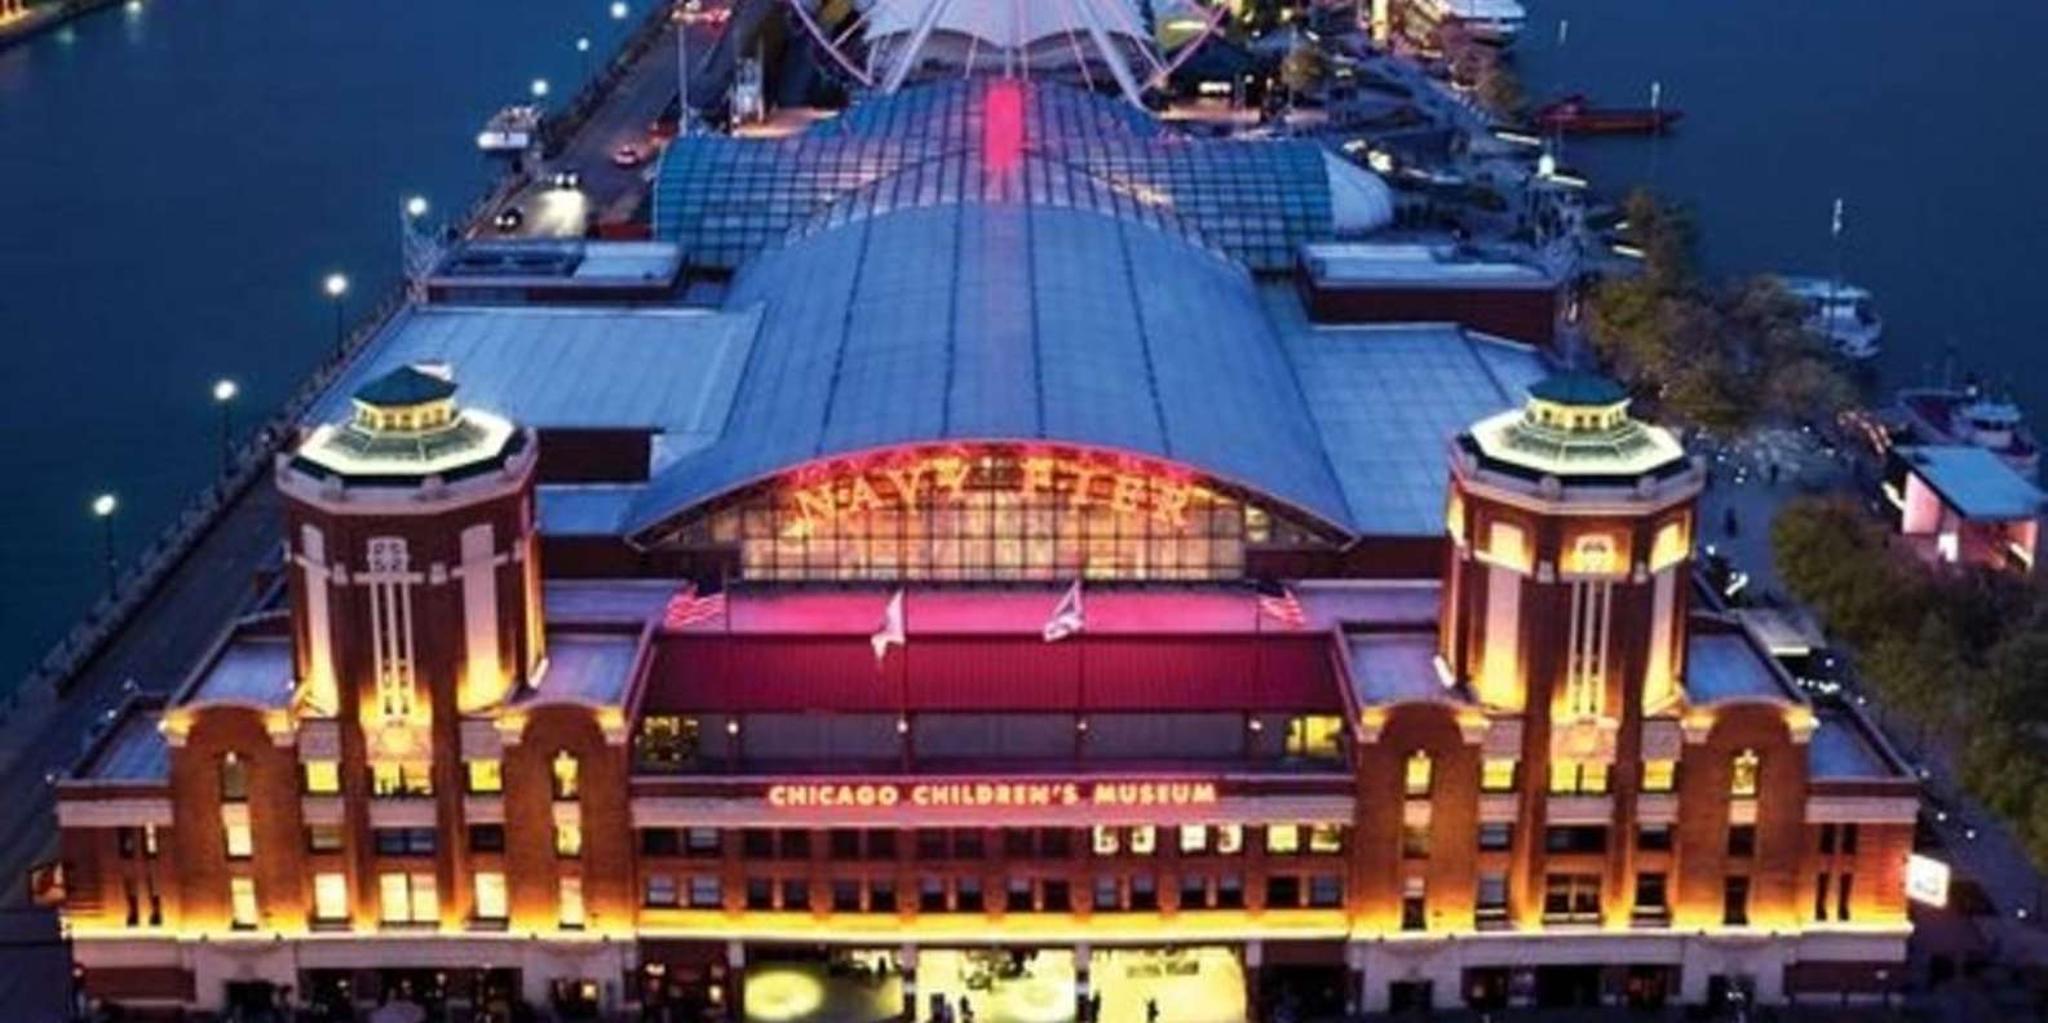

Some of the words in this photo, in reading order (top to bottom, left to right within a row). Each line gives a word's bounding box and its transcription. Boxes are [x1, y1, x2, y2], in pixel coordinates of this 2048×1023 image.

[795, 458, 971, 521] NAVY
[1019, 458, 1192, 526] PIER
[768, 784, 899, 806] CHICAGO
[912, 783, 1079, 806] CHILDREN'S
[1094, 783, 1217, 806] MUSEUM
